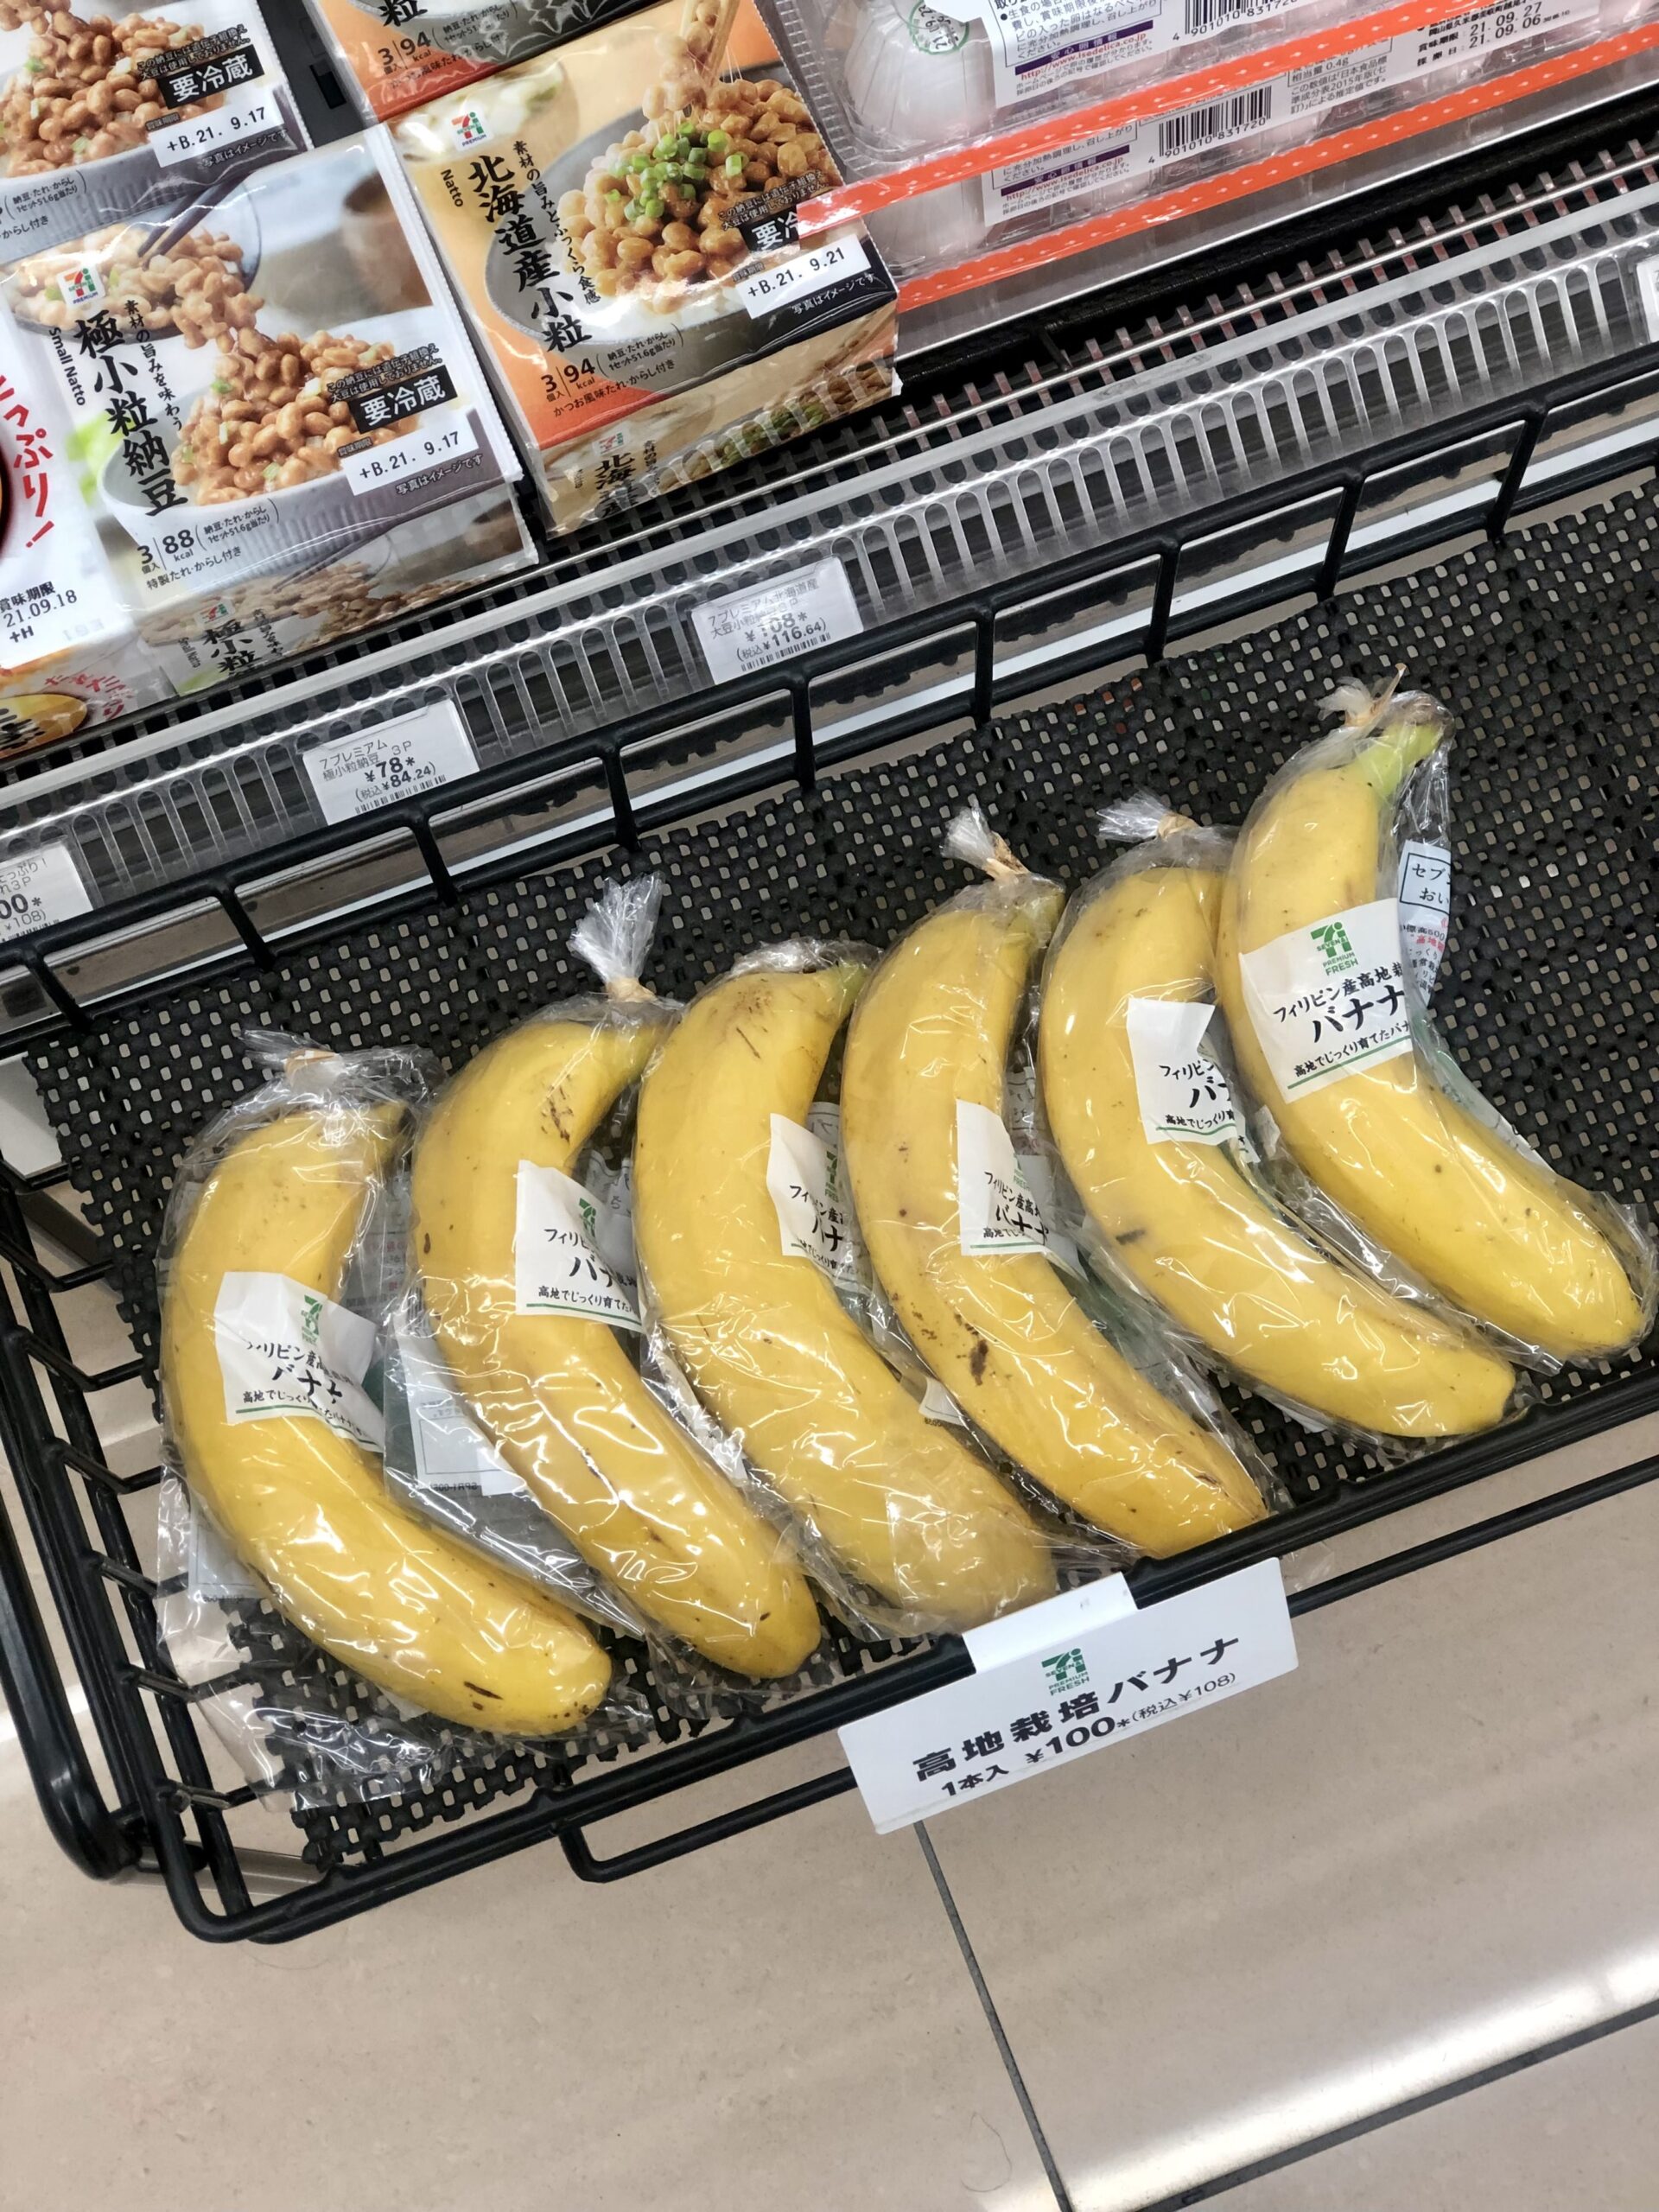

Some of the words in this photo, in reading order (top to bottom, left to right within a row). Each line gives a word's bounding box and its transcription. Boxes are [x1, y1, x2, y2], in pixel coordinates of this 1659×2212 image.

[1522, 14, 1541, 29] 06
[1523, 1, 1542, 17] 27
[378, 48, 395, 67] 3
[400, 31, 432, 56] 94
[1173, 33, 1180, 41] 4
[412, 49, 432, 63] kcal
[168, 53, 253, 103] 要冷蔵
[1164, 136, 1213, 158] 901010
[1217, 117, 1266, 140] 831720
[441, 168, 464, 208] Natto
[467, 154, 592, 353] 北海道産小粒
[48, 327, 72, 365] Small
[65, 362, 86, 406] Natto
[541, 374, 557, 394] 3
[563, 357, 596, 384] 94
[576, 377, 596, 391] kcal
[73, 308, 188, 517] 極小粒納豆
[359, 374, 447, 426] 要冷蔵
[137, 544, 154, 565] 3
[162, 529, 195, 555] 88
[141, 562, 161, 575] 個入
[174, 549, 194, 563] kcal
[3, 589, 79, 628] 21.09.18
[1322, 951, 1356, 968] PREMIUM
[1325, 957, 1359, 976] FRESH
[1273, 961, 1404, 1023] フィリピン産高地栽
[1313, 985, 1405, 1043] バナナ
[1294, 1020, 1412, 1078] 高地でじっくり育てたバナ
[538, 1285, 634, 1313] 高地でじっくり育てた
[1048, 1671, 1089, 1690] PREMIUM
[1050, 1676, 1090, 1696] FRESH
[912, 1637, 1240, 1782] 高地栽培バナナ
[941, 1764, 1010, 1797] 1本入
